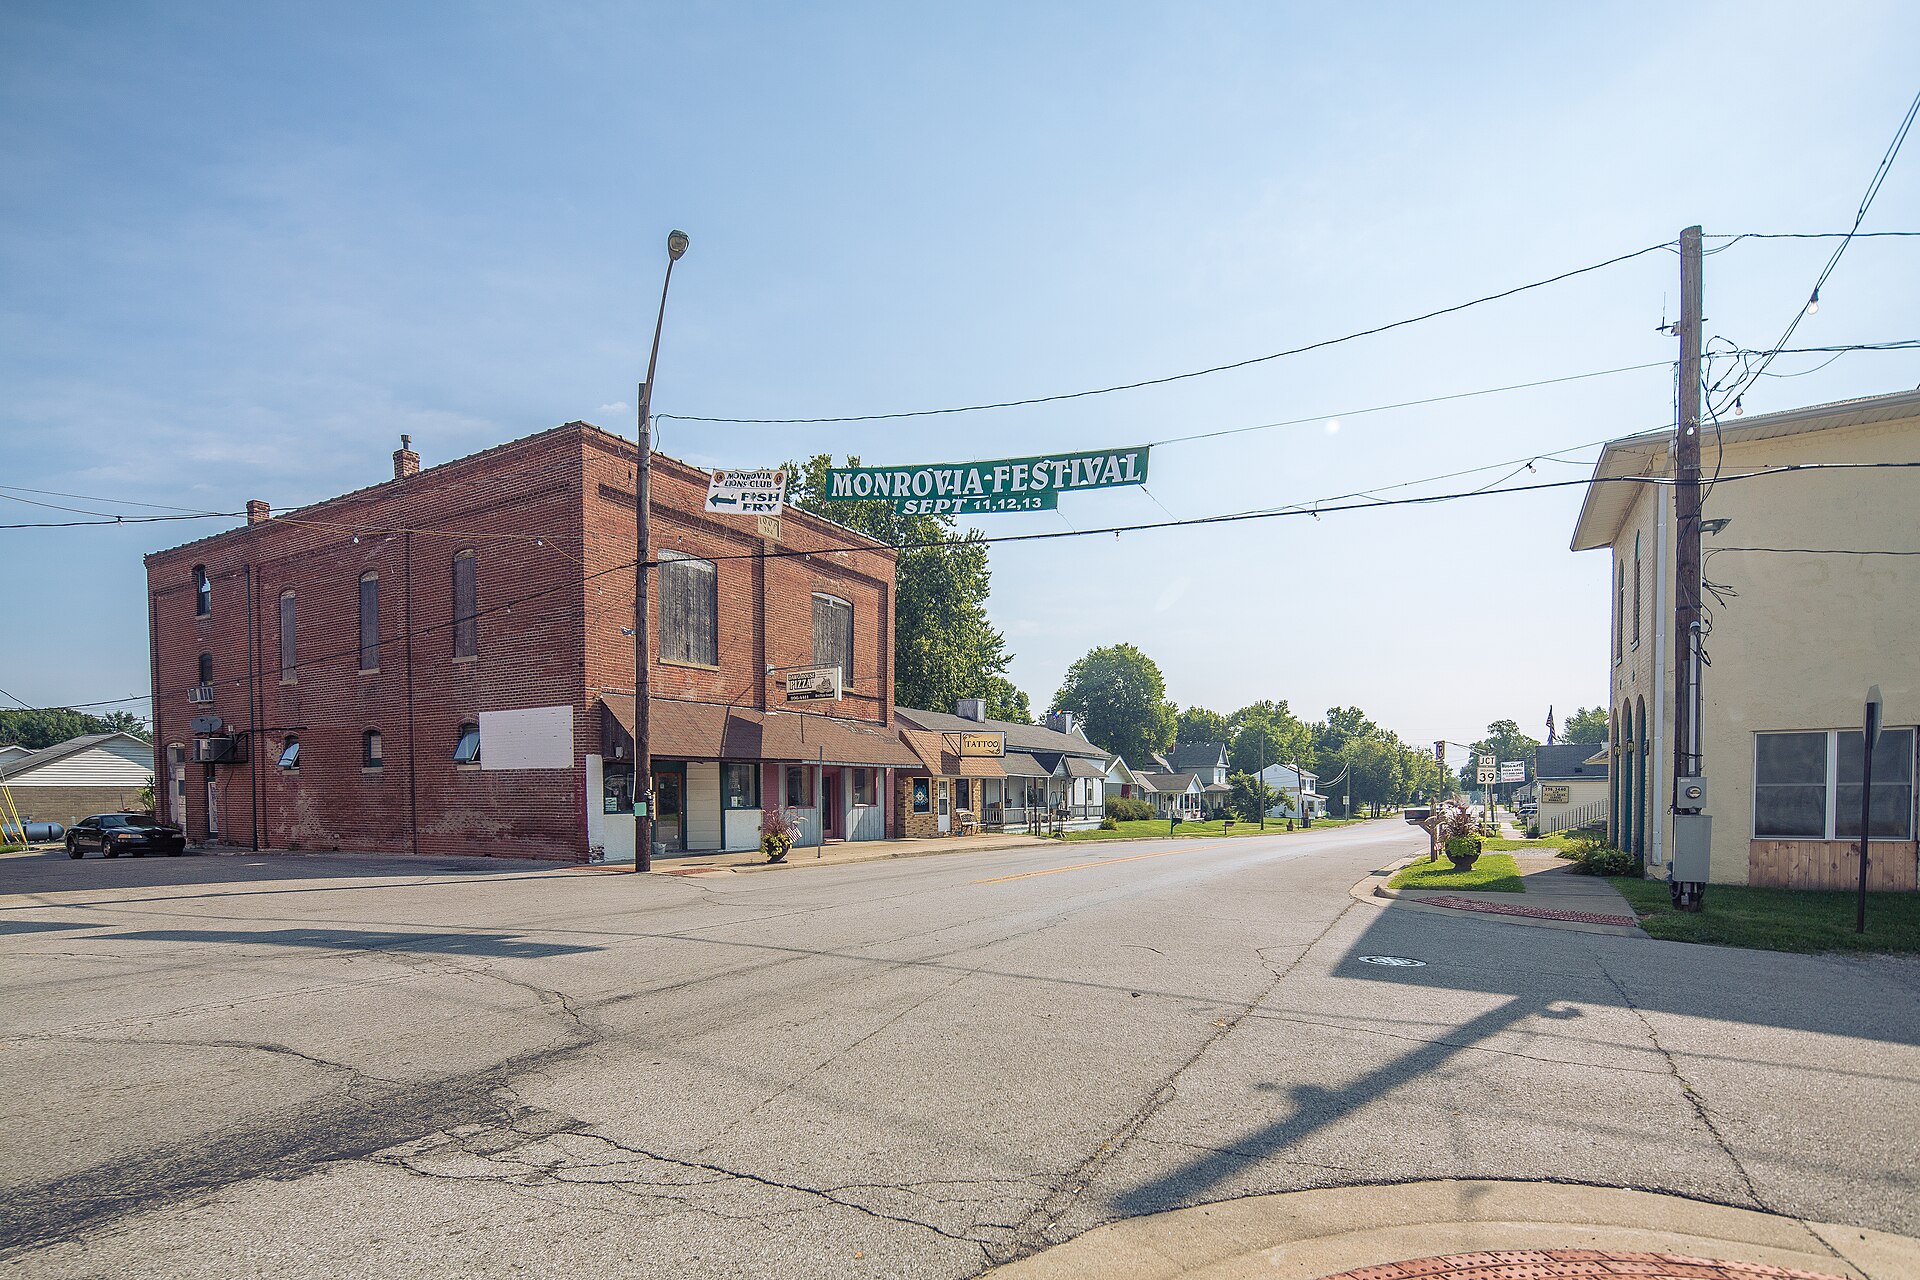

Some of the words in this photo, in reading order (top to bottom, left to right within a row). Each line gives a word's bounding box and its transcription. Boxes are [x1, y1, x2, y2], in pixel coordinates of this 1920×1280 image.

[726, 472, 772, 480] MONROVIA
[831, 468, 984, 497] MONROVIA
[992, 453, 1142, 493] FESTIVAL
[724, 480, 748, 488] LIONS
[749, 480, 772, 488] CLUB
[742, 503, 777, 512] FRY
[901, 498, 968, 515] SEPT
[790, 678, 813, 690] PIZZA
[966, 740, 999, 748] TATTOO
[1480, 757, 1495, 765] JCT
[1479, 772, 1495, 782] 39
